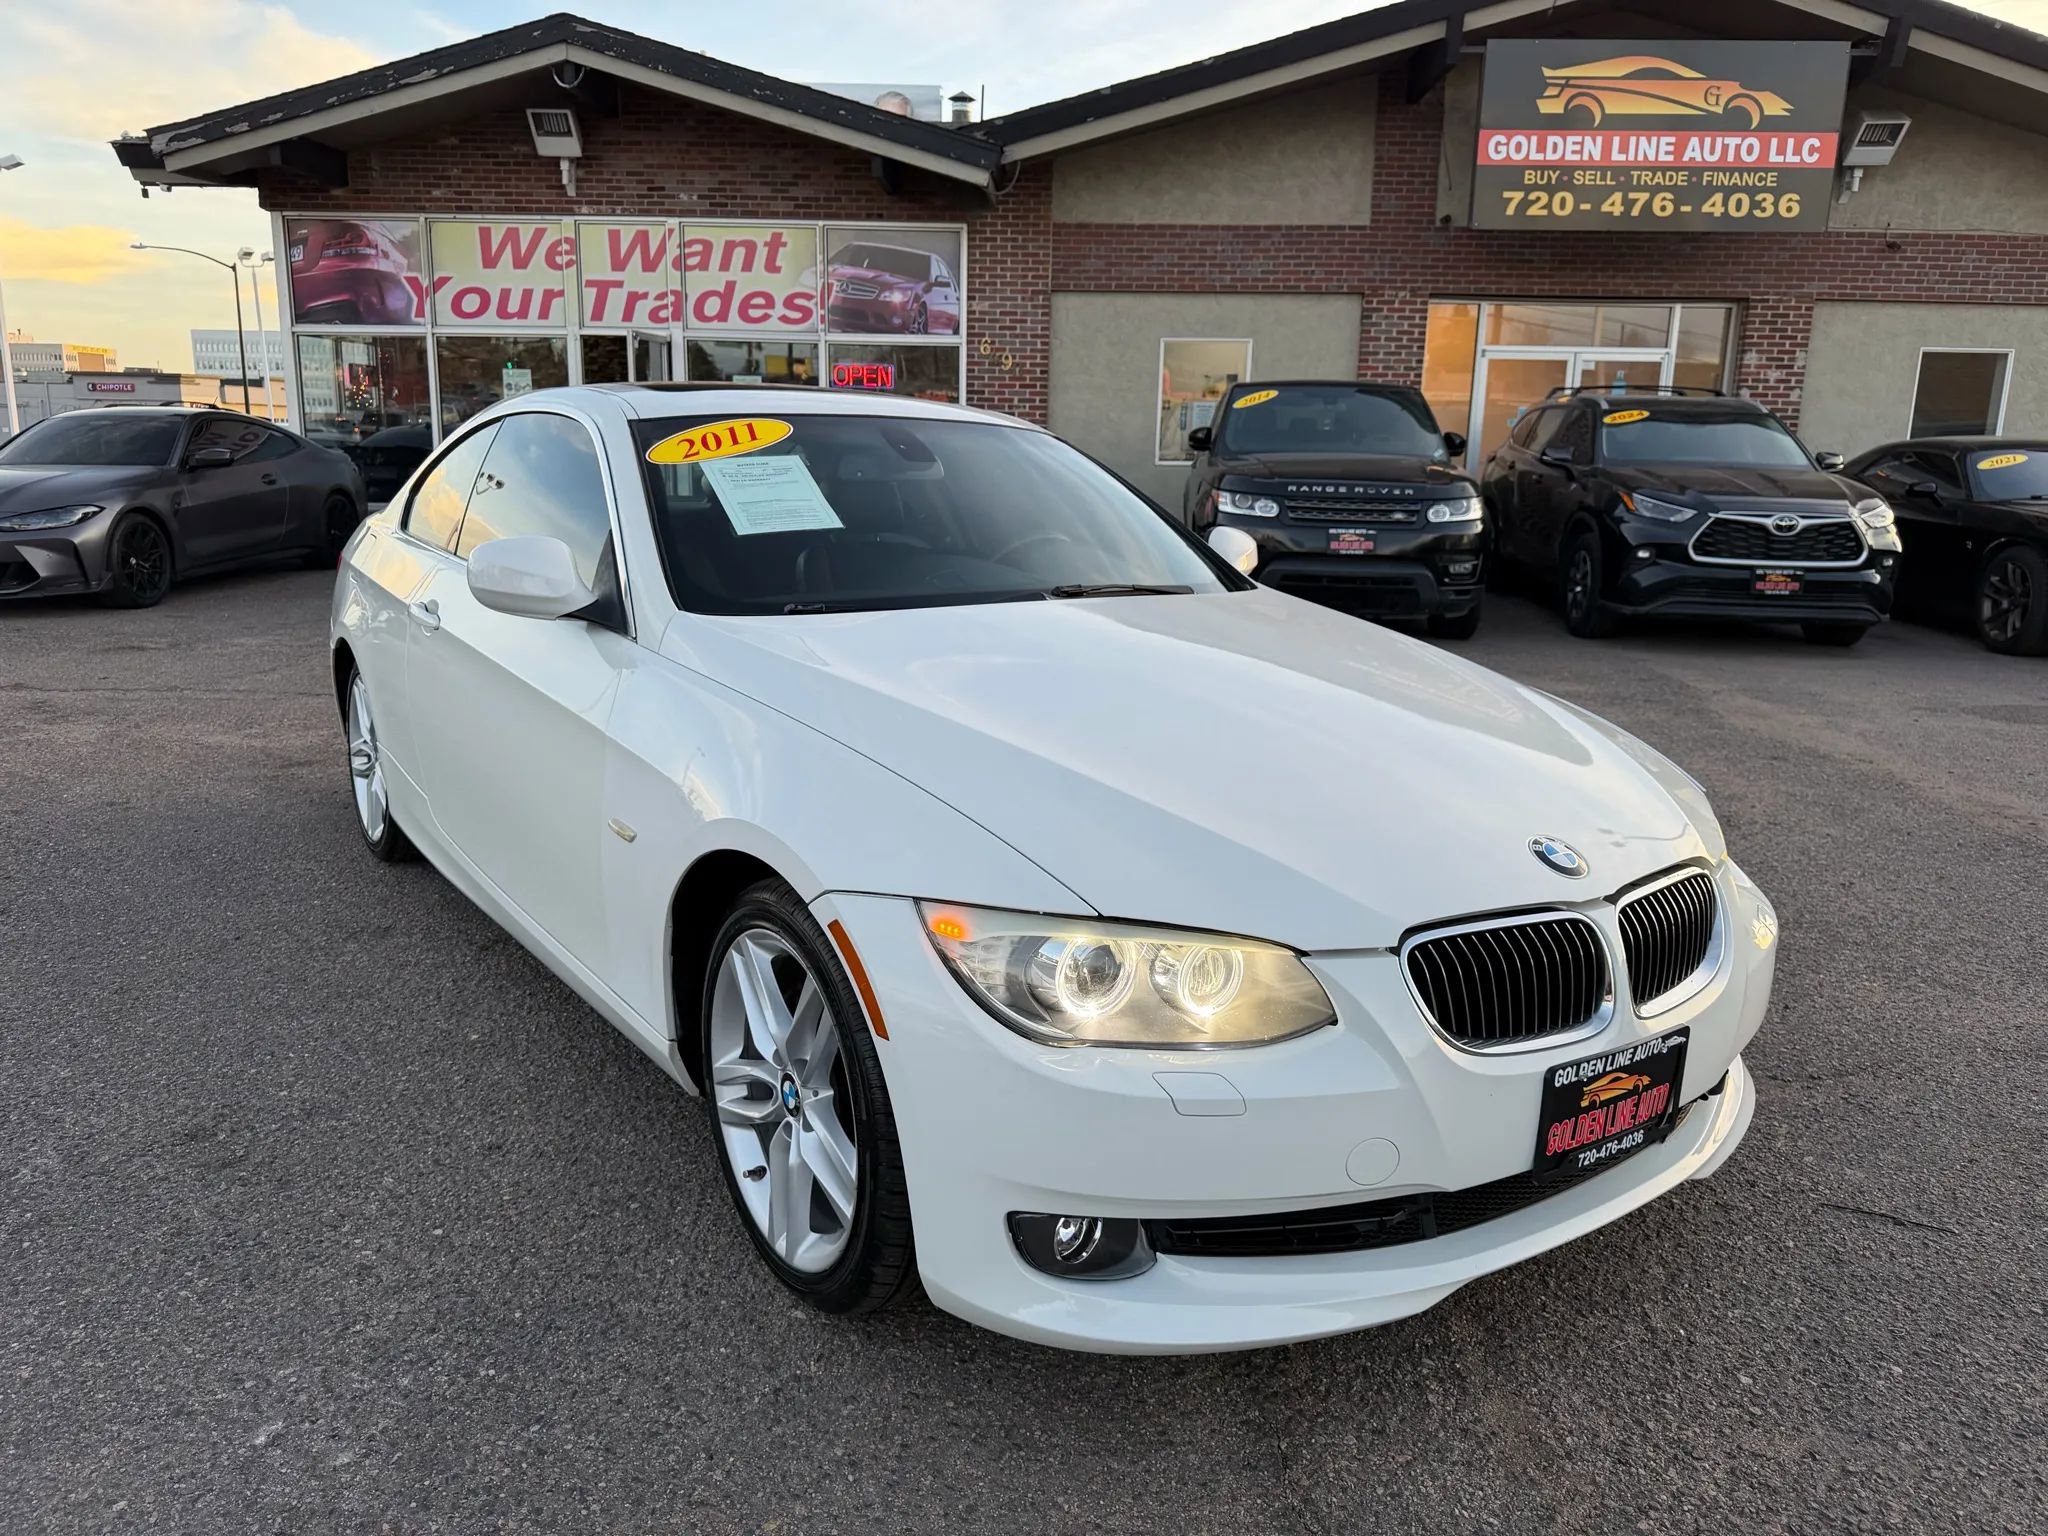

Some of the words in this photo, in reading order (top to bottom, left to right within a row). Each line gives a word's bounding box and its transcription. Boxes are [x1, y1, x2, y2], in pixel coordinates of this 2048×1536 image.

[1488, 134, 1602, 161] GOLDEN
[1611, 136, 1676, 162] LINE
[1683, 137, 1760, 163] AUTO
[1768, 137, 1821, 164] LLC
[1524, 170, 1560, 185] BUY
[1573, 170, 1616, 186] SELL
[1631, 170, 1688, 186] TRADE
[1702, 171, 1778, 187] FINANCE
[478, 226, 577, 272] We
[607, 228, 788, 274] Want
[403, 276, 566, 320] Your
[584, 279, 835, 326] Trades!
[833, 363, 893, 389] OPEN
[677, 422, 761, 459] 2011
[1988, 455, 2017, 467] 2021
[1287, 484, 1347, 493] RANGE
[1354, 486, 1415, 496] ROVER
[1554, 1058, 1605, 1087] GOLDEN
[1606, 1047, 1633, 1072] LINE
[1633, 1037, 1662, 1061] AUTO
[1546, 1107, 1606, 1156] GOLDEN
[1606, 1095, 1638, 1136] LINE
[1635, 1083, 1670, 1126] AUTO
[1578, 1130, 1644, 1168] 720-476-4036
